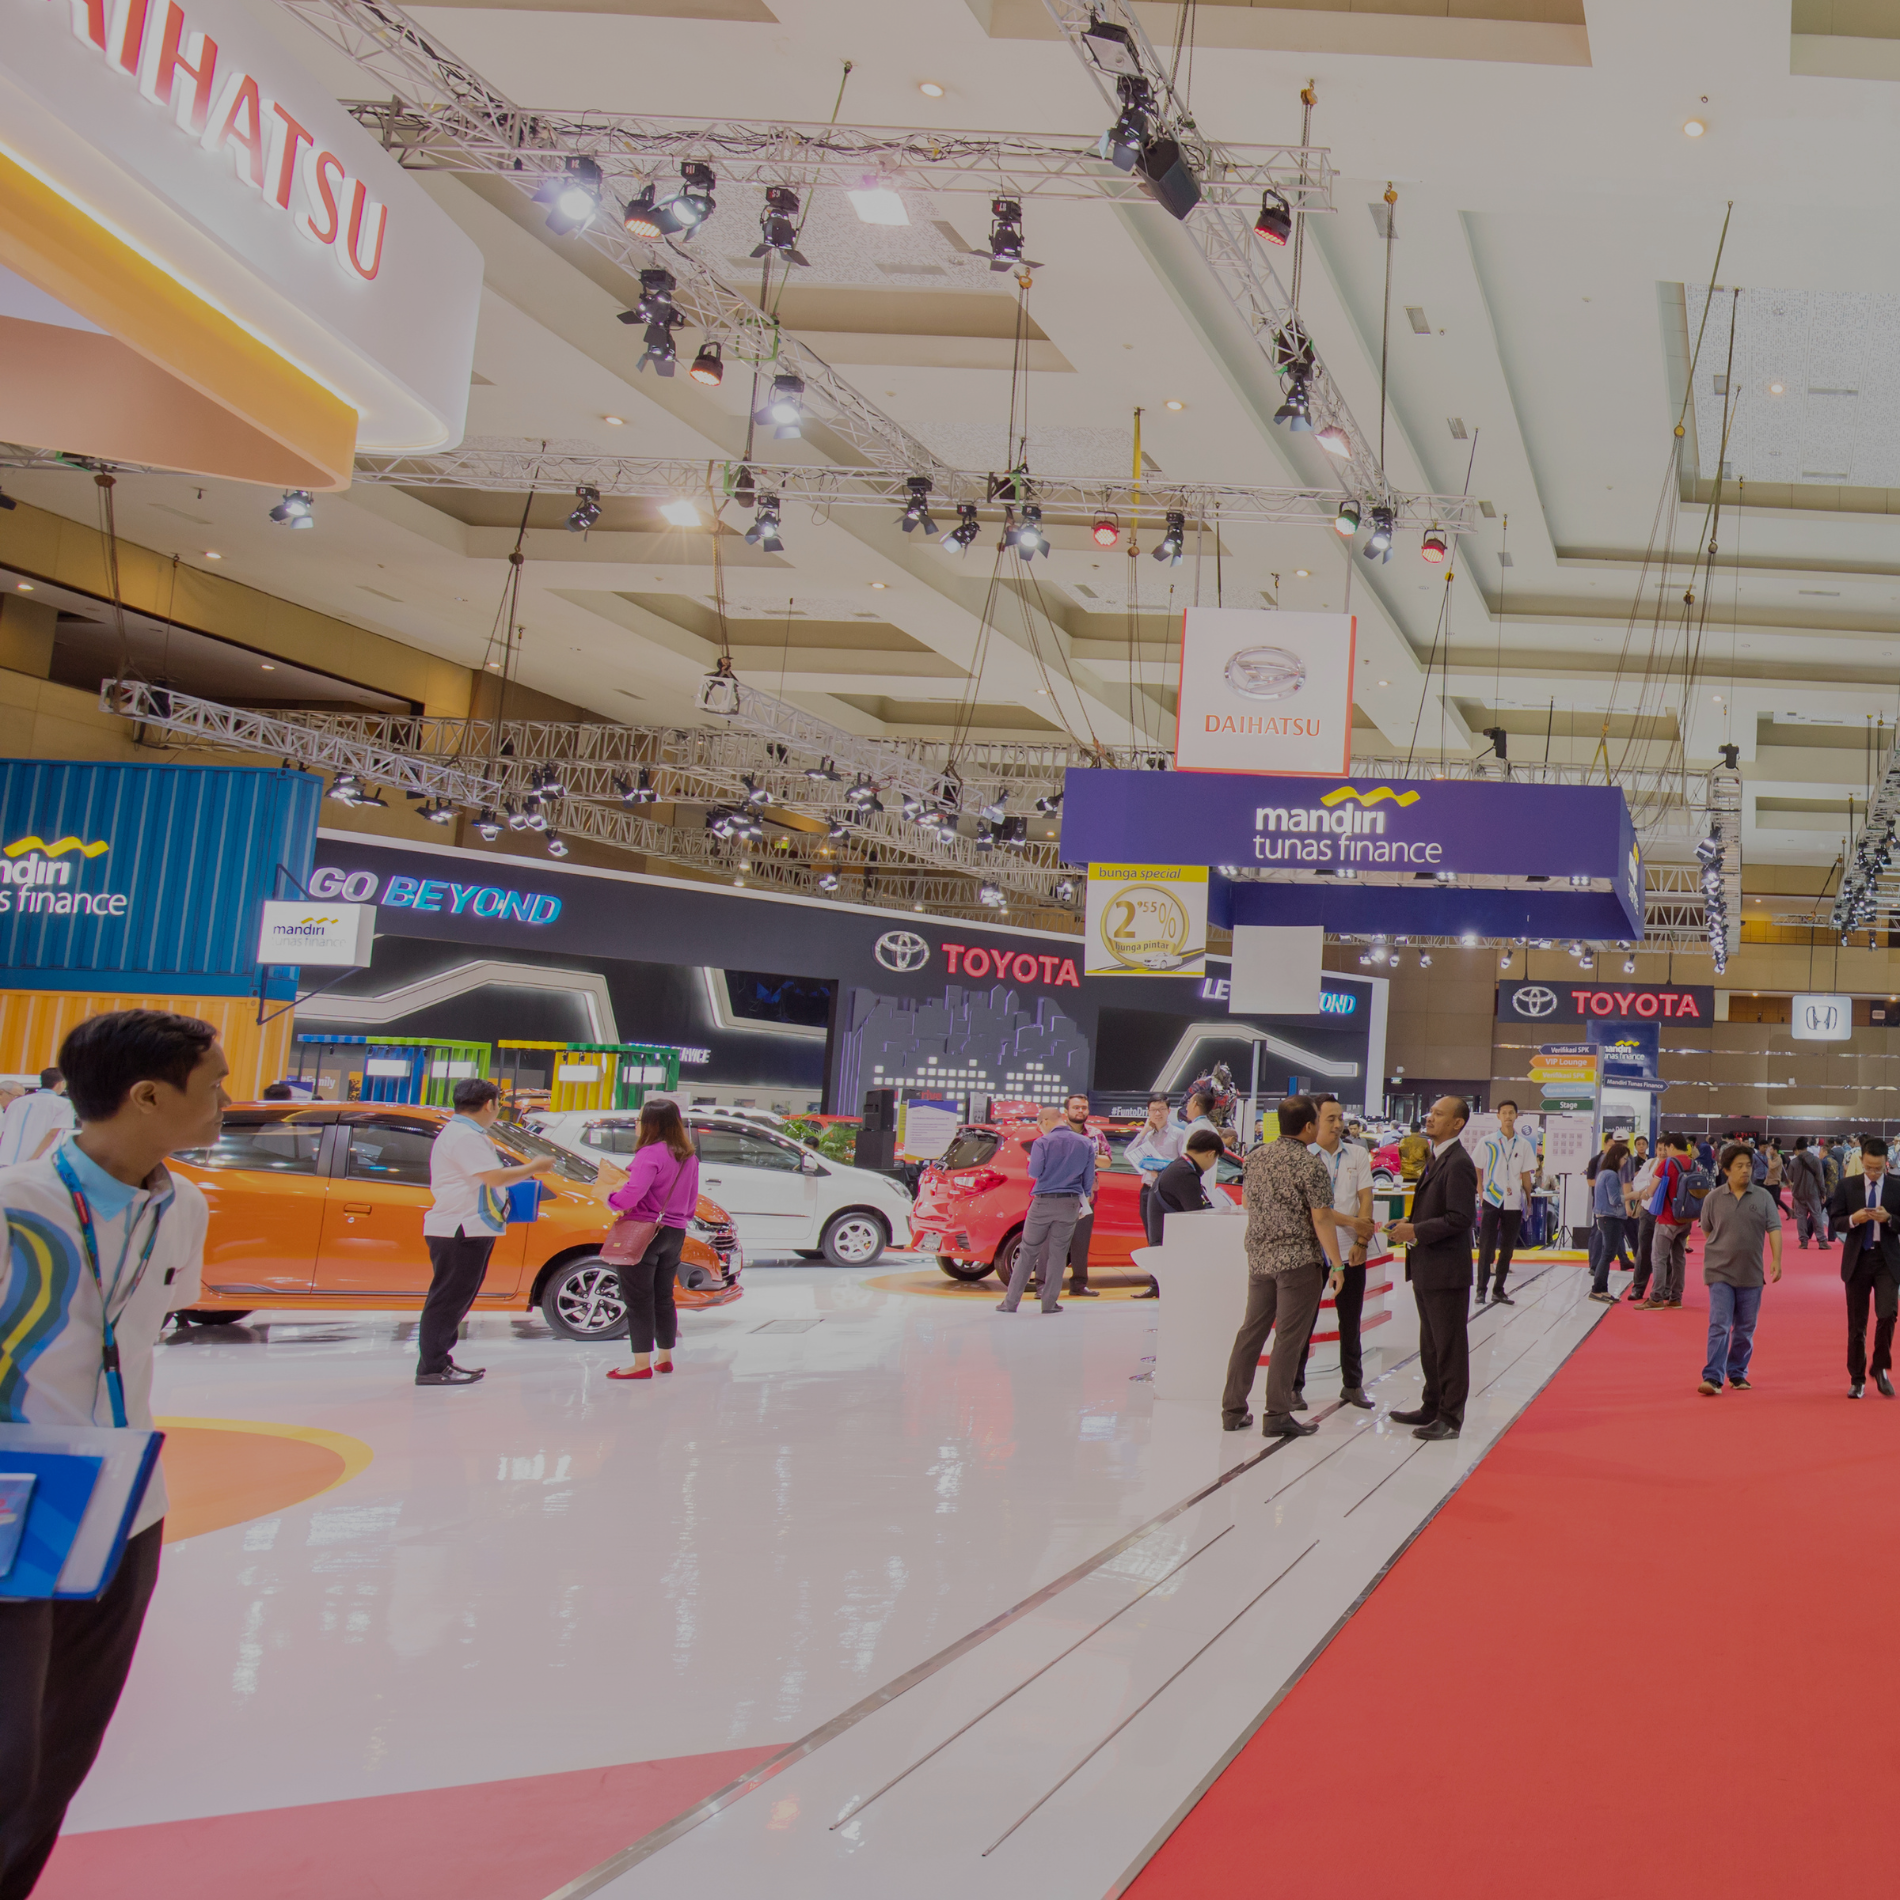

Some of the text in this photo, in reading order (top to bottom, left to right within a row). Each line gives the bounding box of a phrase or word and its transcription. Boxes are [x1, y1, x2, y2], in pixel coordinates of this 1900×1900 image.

[1204, 714, 1320, 737] DAIHATSU
[1254, 802, 1385, 834] mandiri
[1252, 831, 1443, 863] tunas finance
[0, 853, 71, 885] ndiri
[1099, 867, 1181, 880] bunga special
[18, 883, 128, 915] finance
[308, 867, 562, 924] GO BEYOND
[273, 924, 325, 936] mandiri
[1115, 941, 1169, 953] bunga pintar
[941, 943, 1080, 987] TOYOTA
[1571, 990, 1700, 1018] TOYOTA
[1550, 1046, 1577, 1054] Verifikasi
[1559, 1058, 1588, 1067] Lounge
[1542, 1071, 1571, 1079] Verifikasi
[1643, 1081, 1664, 1089] Finance
[1559, 1101, 1578, 1109] Stage
